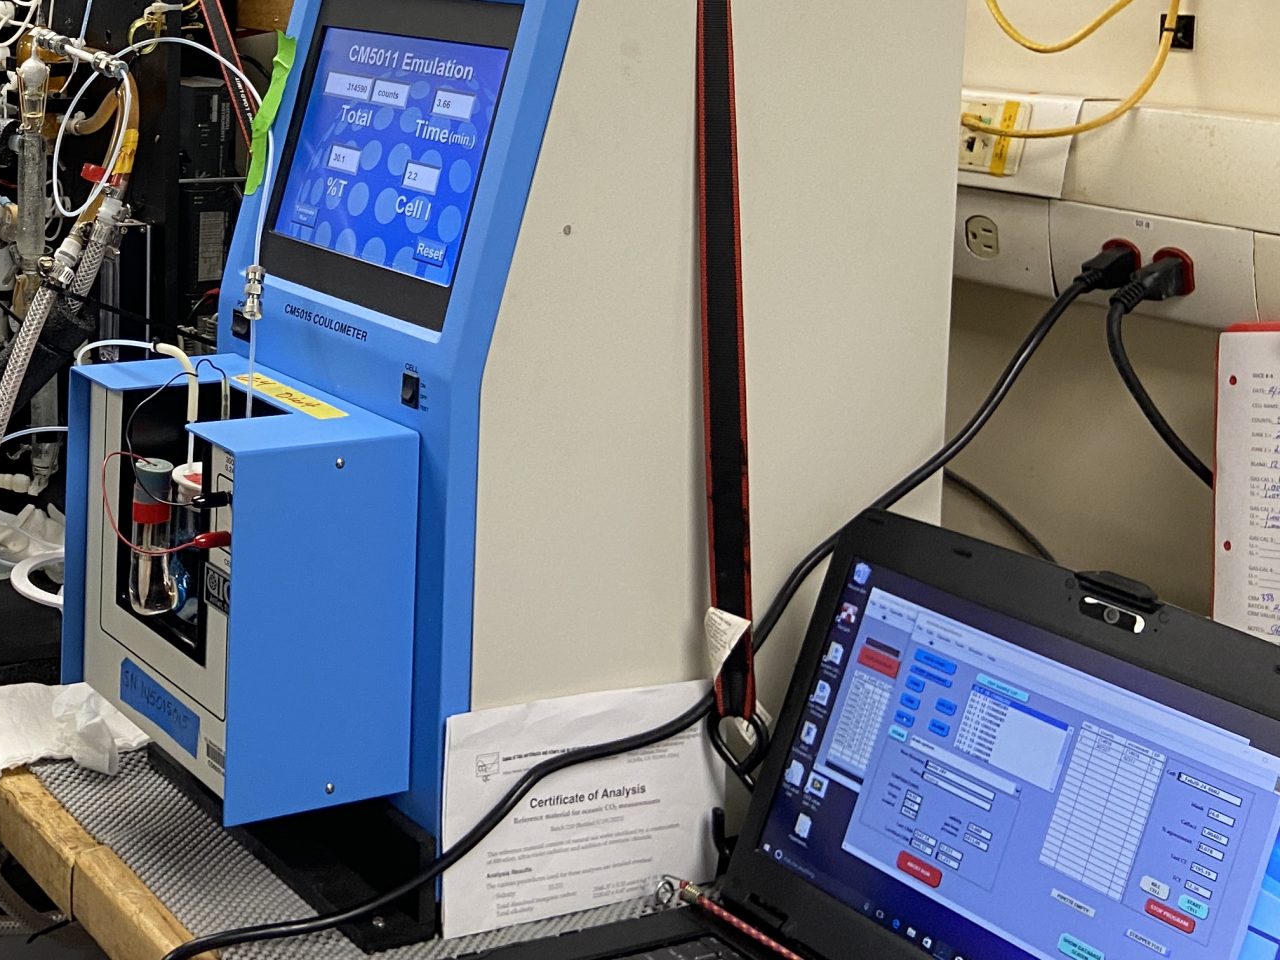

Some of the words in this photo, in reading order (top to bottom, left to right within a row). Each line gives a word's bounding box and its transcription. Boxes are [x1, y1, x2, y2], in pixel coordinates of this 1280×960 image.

[348, 44, 400, 68] CM5011
[401, 53, 474, 80] Emulation
[377, 90, 399, 100] counts
[436, 99, 451, 109] 3.66
[341, 104, 373, 127] Total
[415, 119, 449, 143] Time
[407, 171, 419, 182] 2.2
[326, 177, 348, 197] %T
[395, 195, 424, 221] Cell
[416, 242, 445, 262] Reset
[284, 303, 312, 322] CM5015
[313, 313, 368, 341] COULOMETER
[404, 362, 419, 374] CELL
[530, 792, 585, 809] Certificate
[588, 790, 599, 801] of
[601, 783, 646, 799] Analysis
[1163, 909, 1189, 927] PROGRAM
